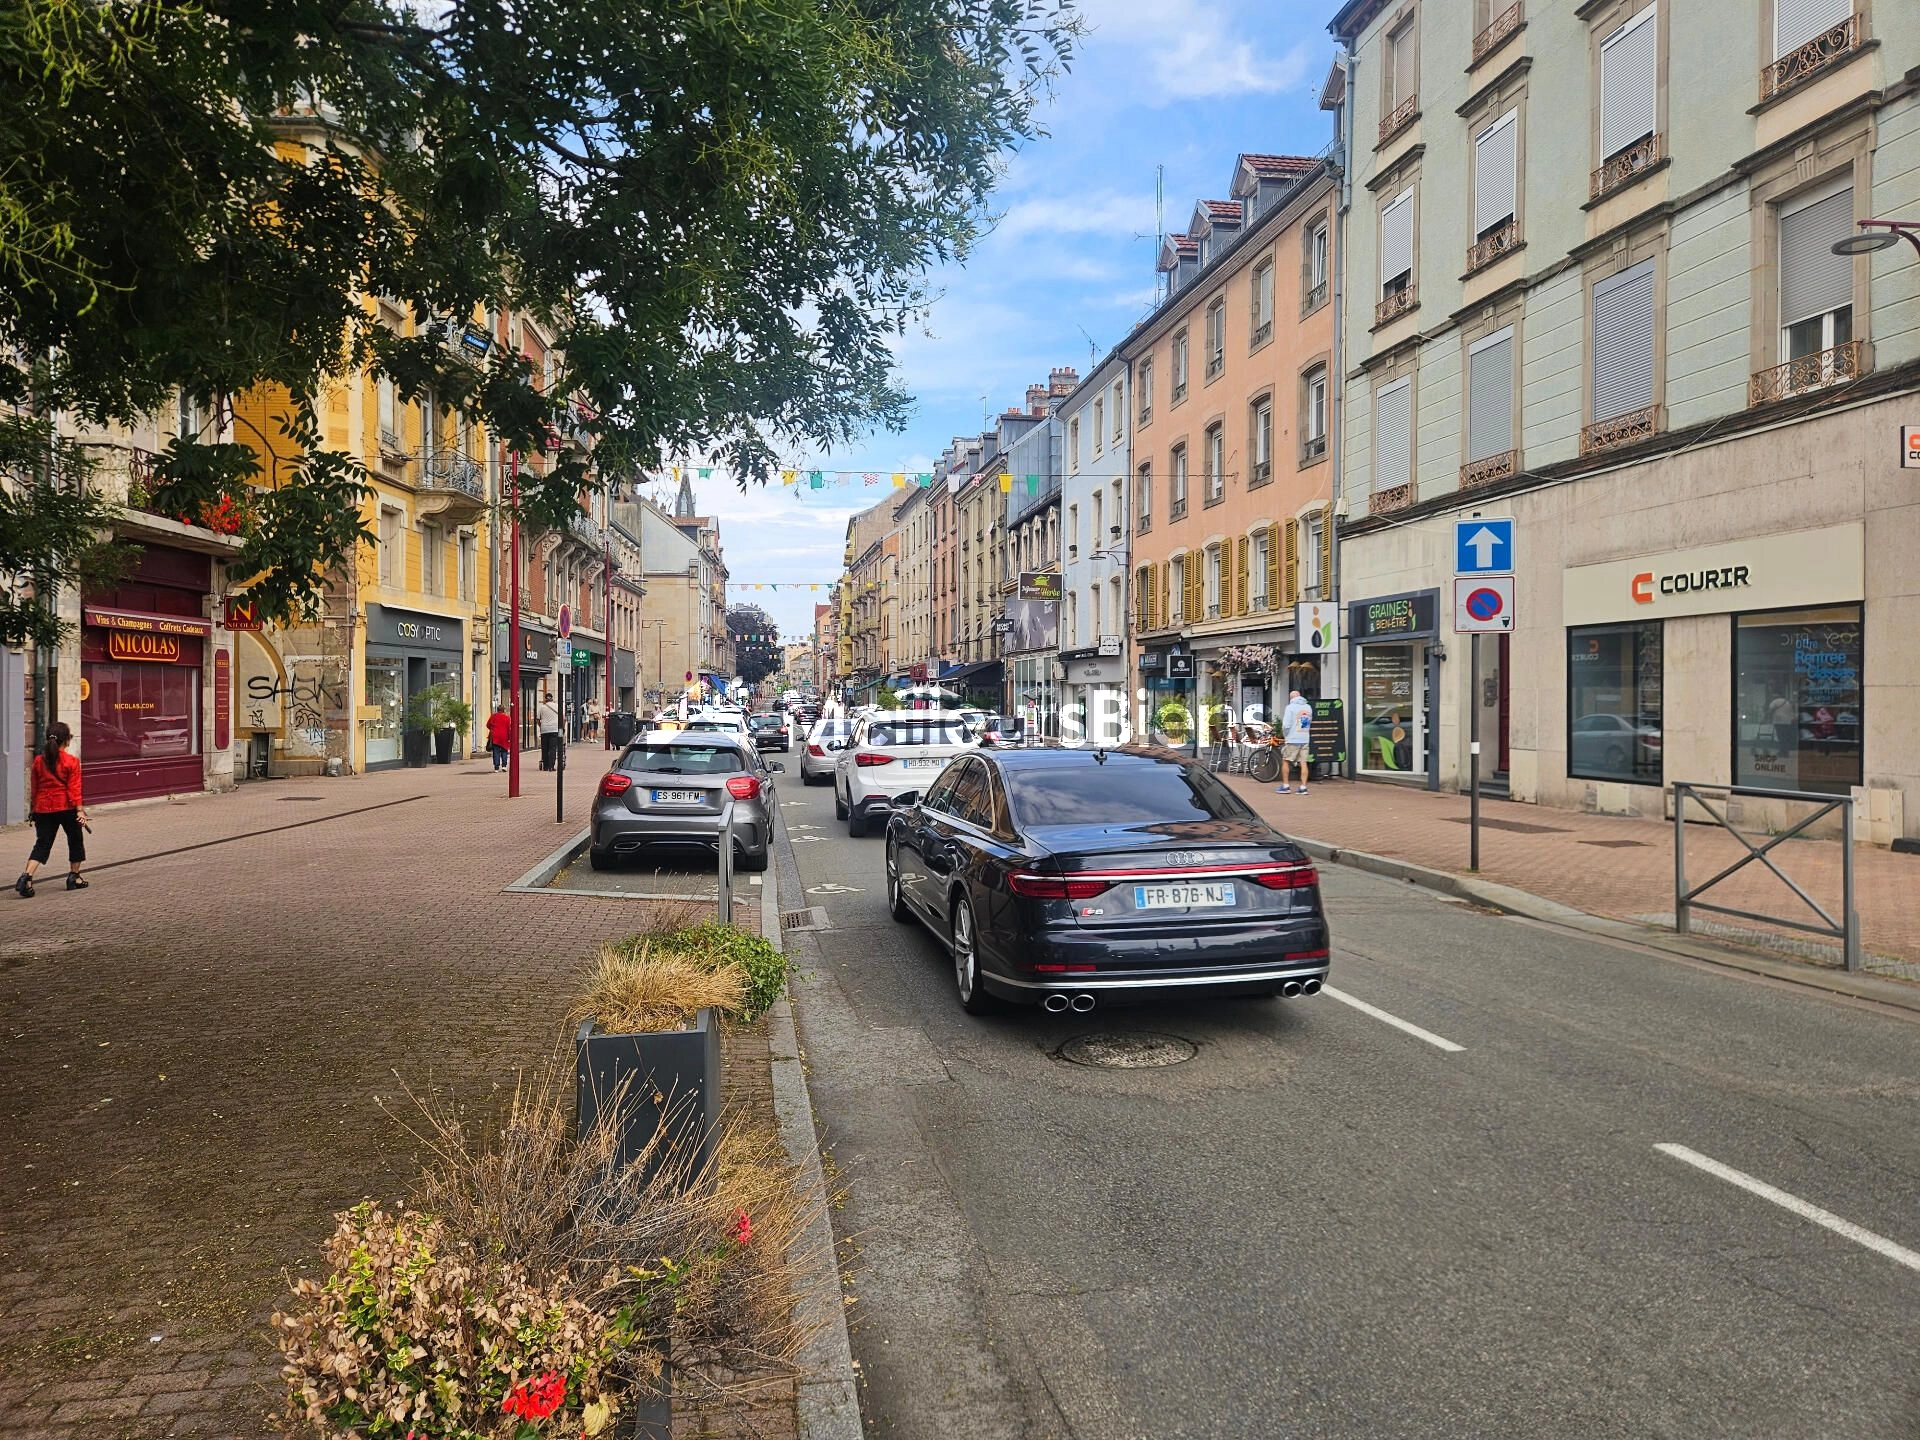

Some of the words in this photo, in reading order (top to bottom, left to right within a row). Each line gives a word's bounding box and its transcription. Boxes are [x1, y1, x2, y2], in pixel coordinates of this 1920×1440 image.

[1660, 565, 1749, 594] COURIR
[1368, 599, 1409, 619] GRAINES
[96, 614, 110, 625] Vins
[111, 617, 116, 626] &
[117, 615, 153, 630] Champagnes
[159, 621, 182, 633] Coffrets
[182, 624, 204, 635] Cadeaux
[397, 622, 420, 638] COSY
[114, 632, 176, 655] NICOLAS
[1754, 763, 1786, 773] ONLINE
